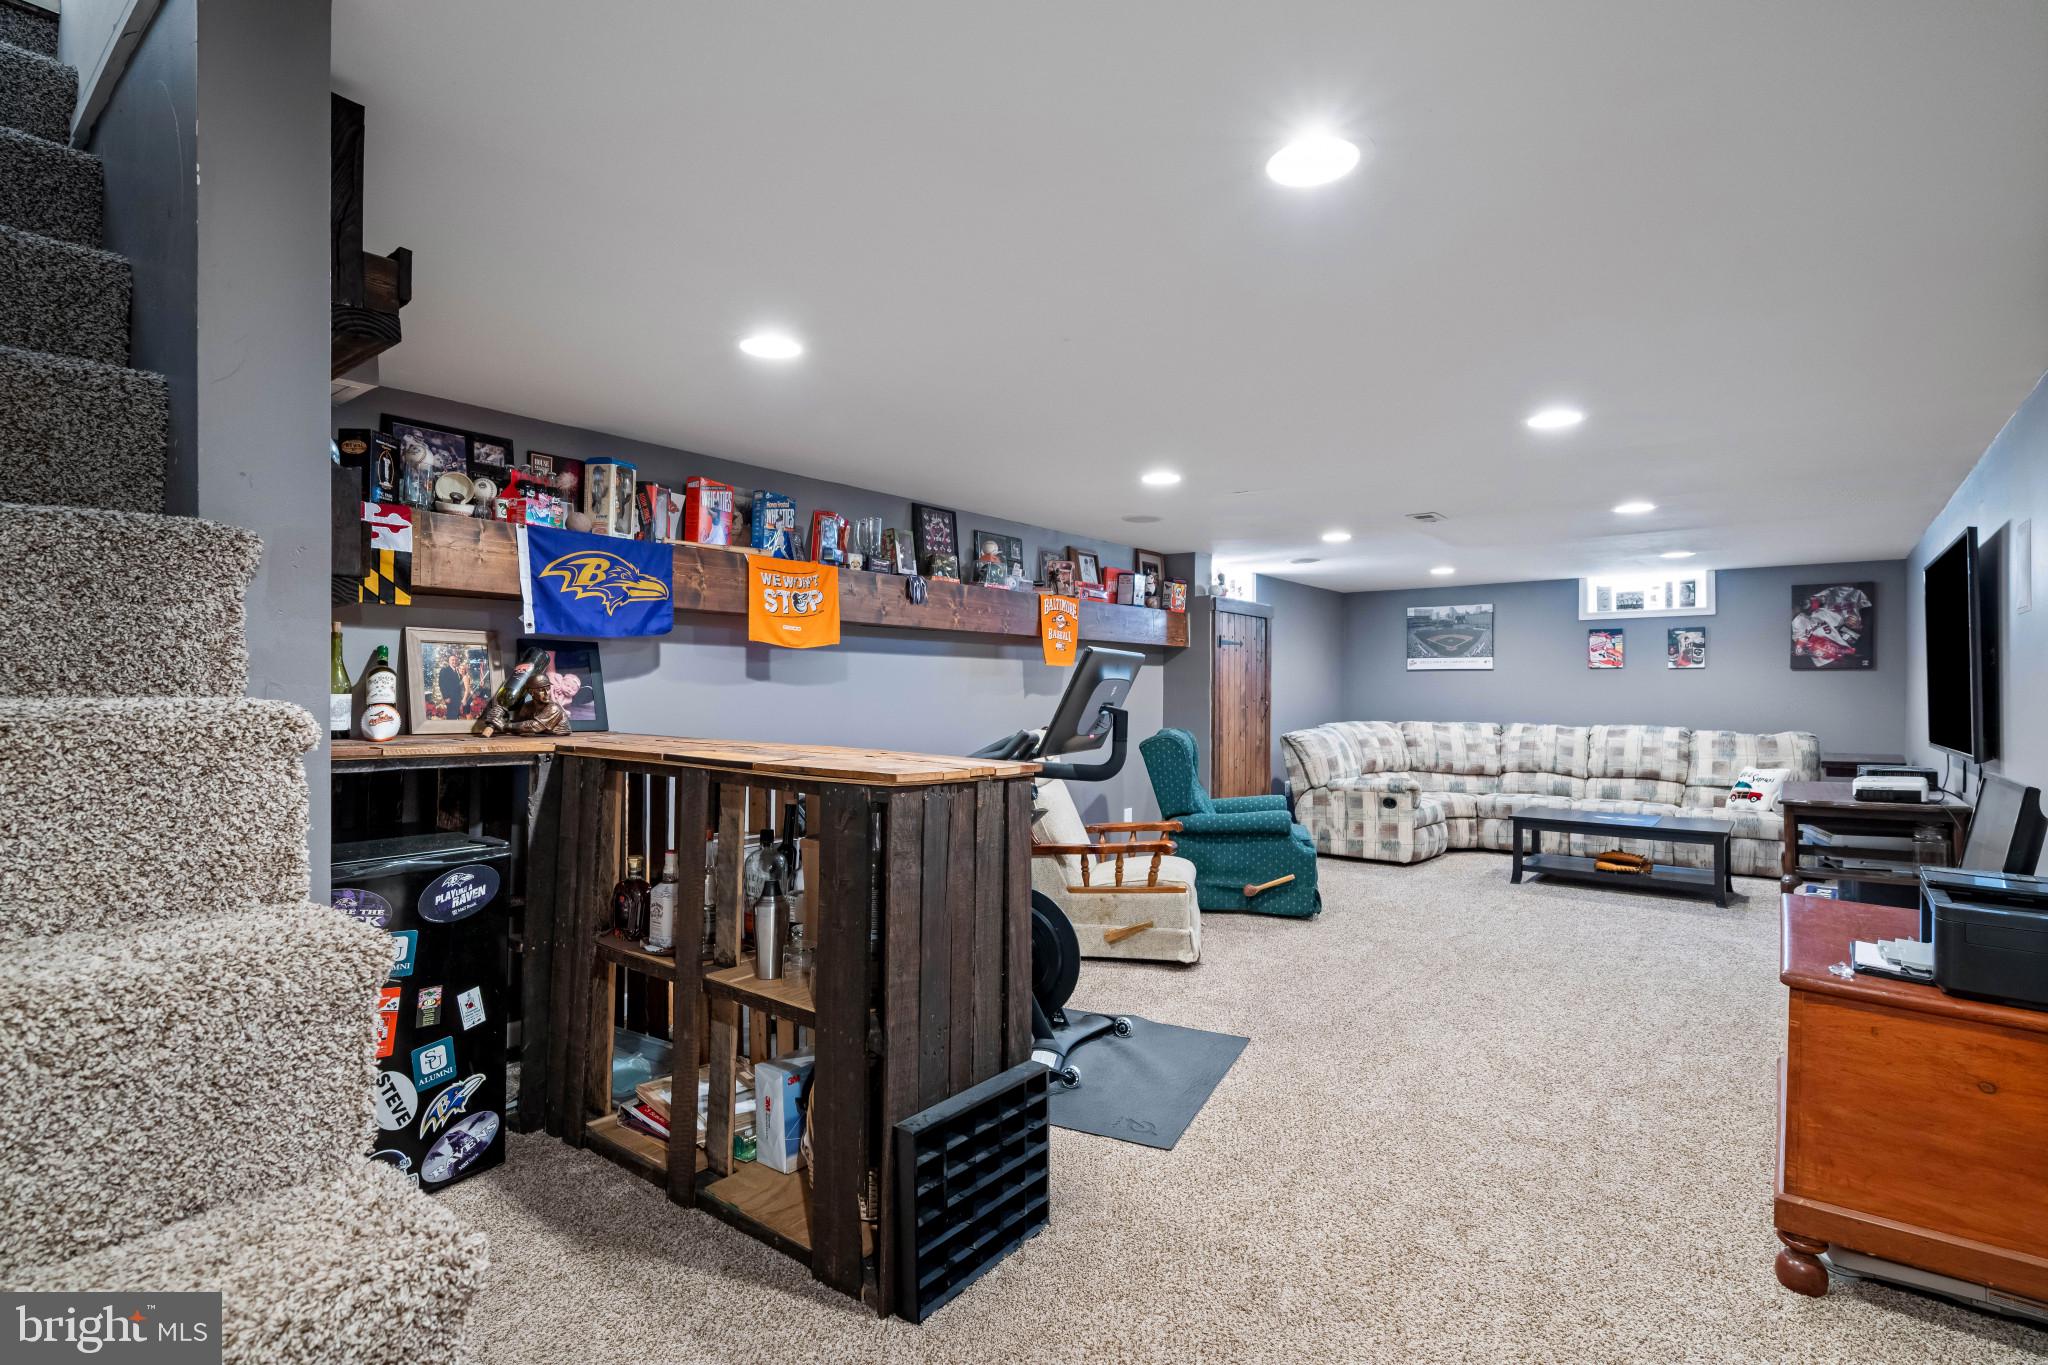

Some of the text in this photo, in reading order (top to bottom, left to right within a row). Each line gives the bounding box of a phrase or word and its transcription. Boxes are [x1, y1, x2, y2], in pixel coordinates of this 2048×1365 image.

[760, 572, 819, 588] WE WON'T
[1043, 598, 1078, 621] BALTIMORE
[434, 888, 457, 906] PLAY
[451, 884, 487, 908] RAVEN
[418, 1066, 454, 1086] ALUMNI
[376, 1073, 412, 1127] STEVE
[429, 1121, 497, 1179] RAVENS
